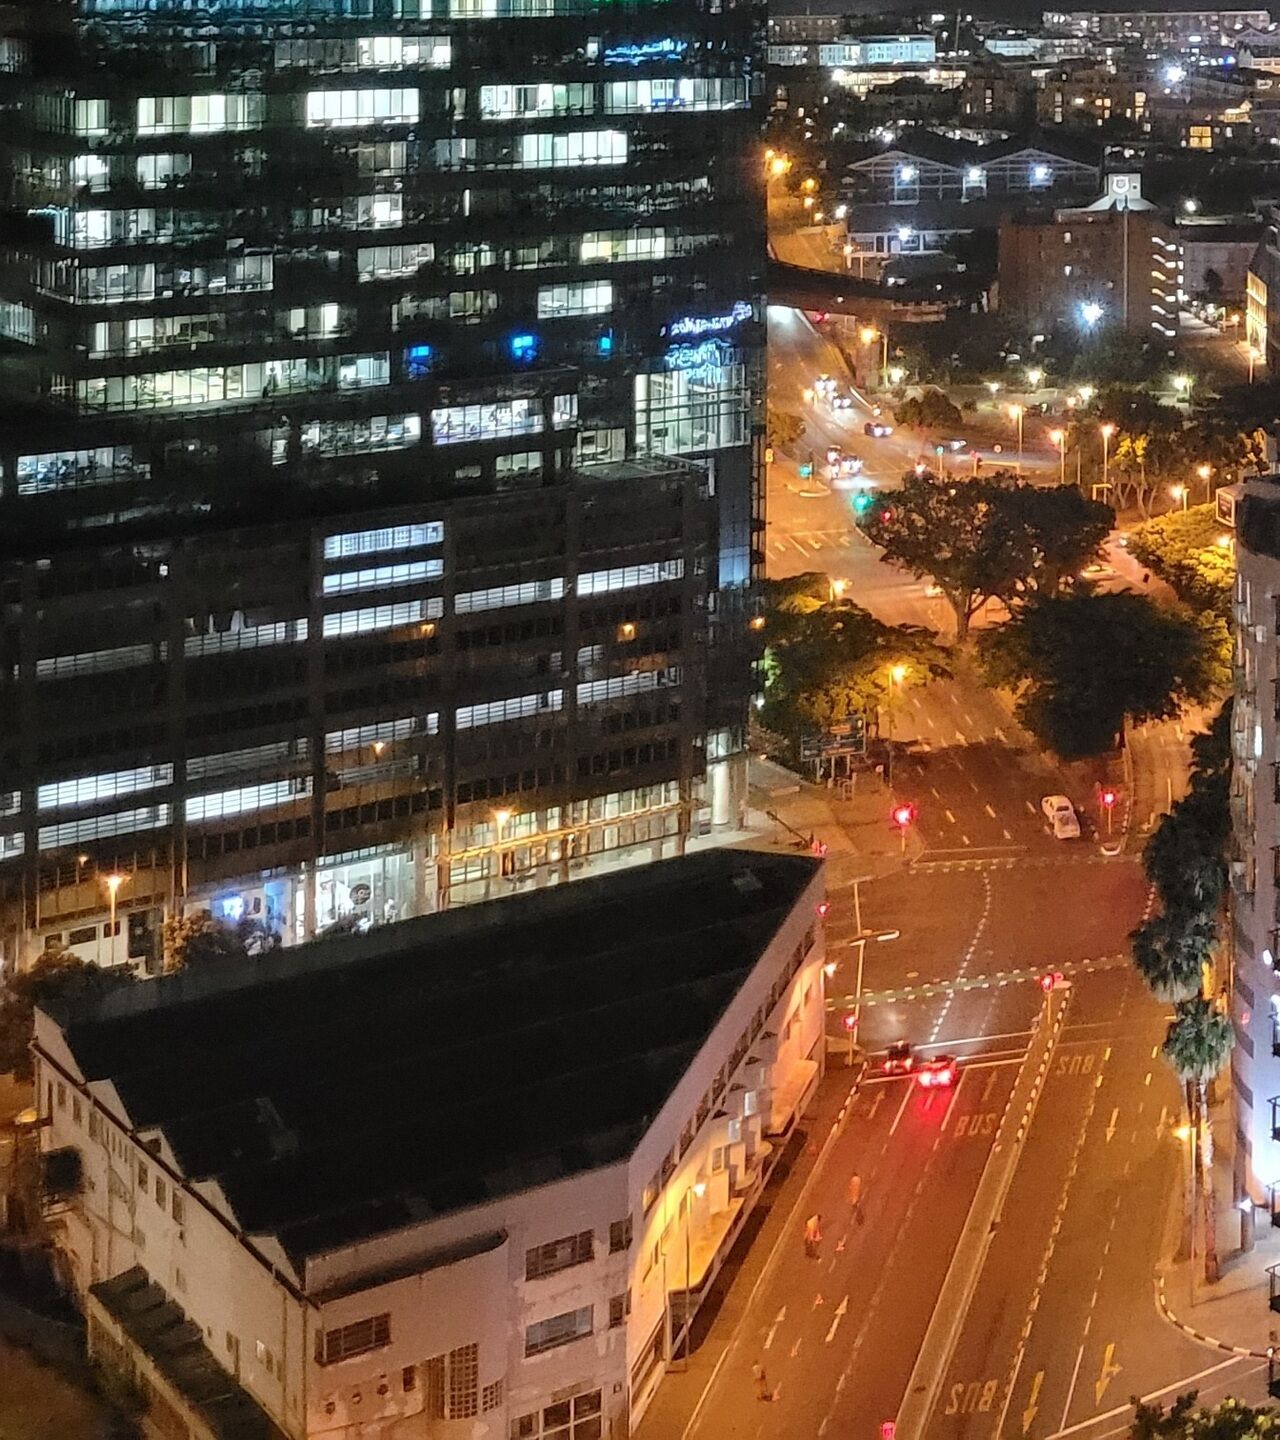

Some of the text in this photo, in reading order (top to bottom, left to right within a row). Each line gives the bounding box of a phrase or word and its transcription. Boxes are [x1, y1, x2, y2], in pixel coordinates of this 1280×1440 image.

[1055, 1054, 1096, 1077] BUS
[953, 1112, 998, 1137] BUS
[944, 1379, 998, 1415] BUS
